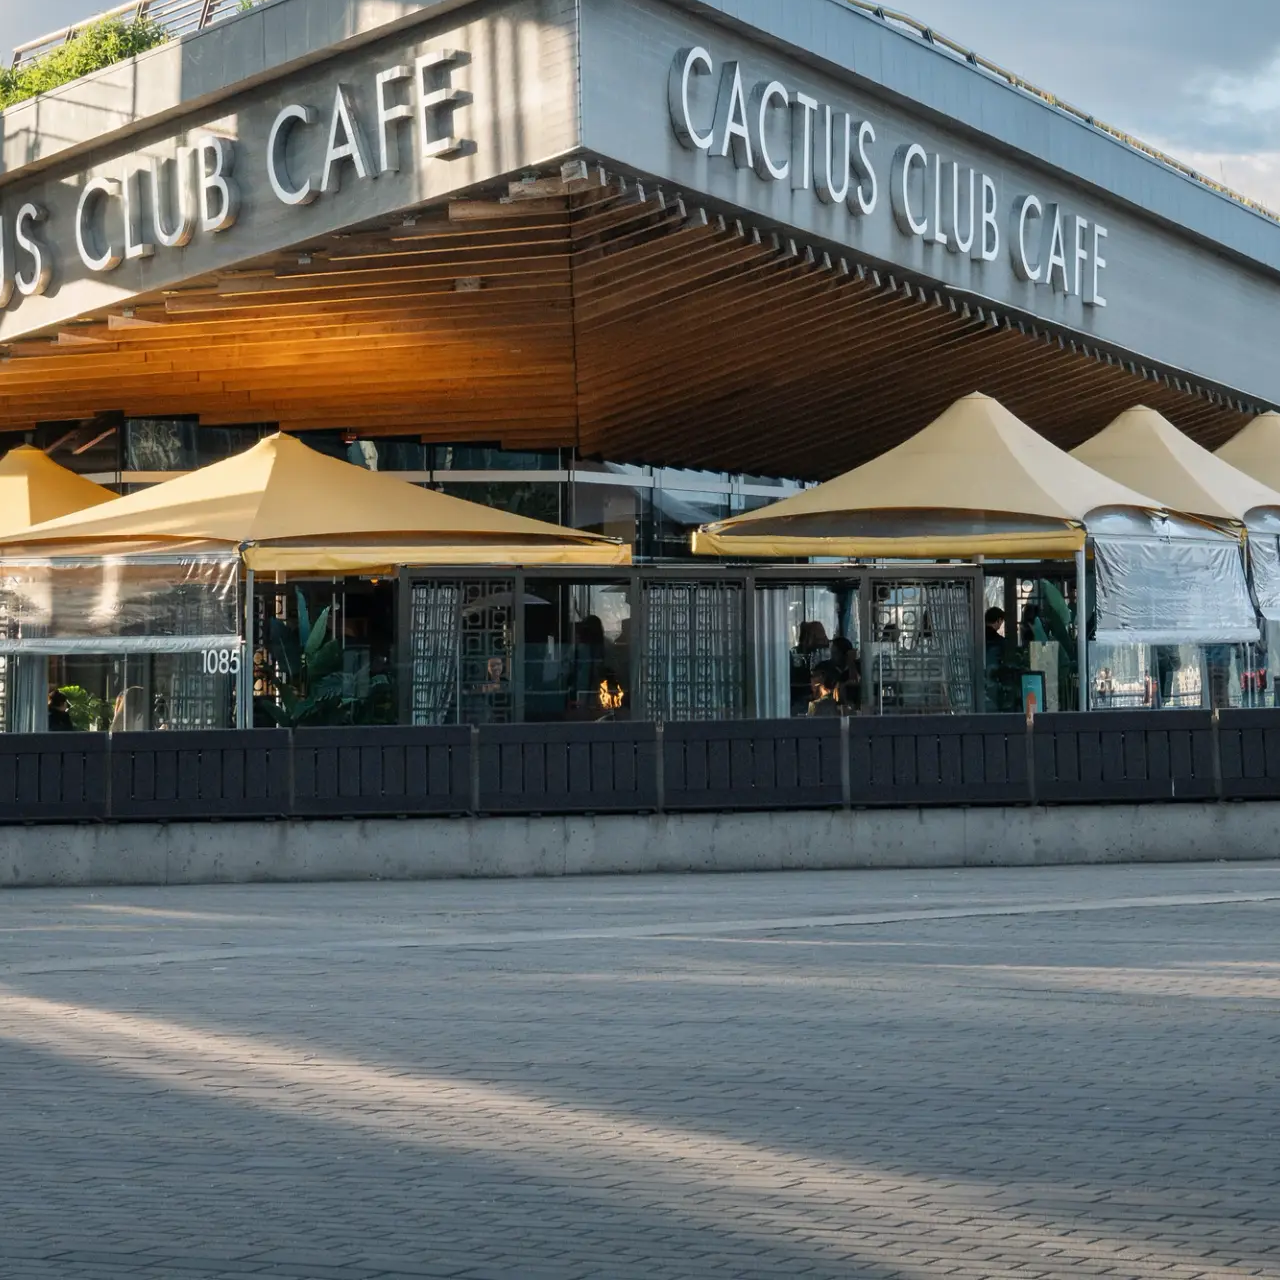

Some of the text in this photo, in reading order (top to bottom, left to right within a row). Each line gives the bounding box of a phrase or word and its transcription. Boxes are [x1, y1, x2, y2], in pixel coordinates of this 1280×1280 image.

[75, 135, 237, 272] CLUB
[267, 48, 466, 206] CAFE
[670, 45, 1108, 307] CACTUS CLUB CAFE
[200, 648, 241, 674] 1085
